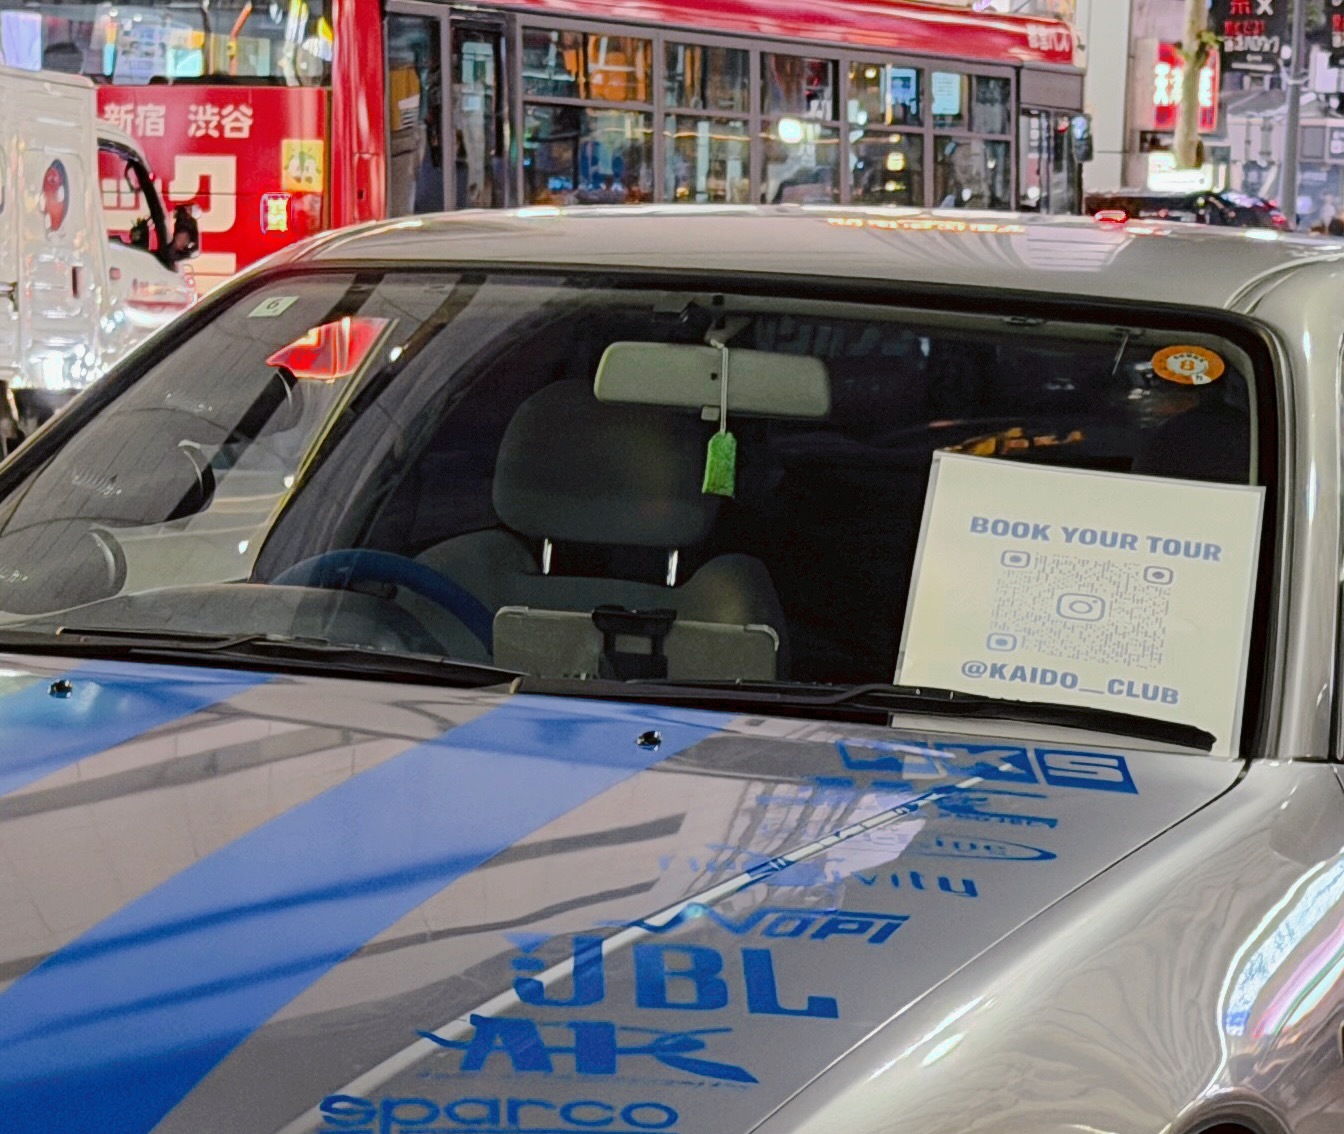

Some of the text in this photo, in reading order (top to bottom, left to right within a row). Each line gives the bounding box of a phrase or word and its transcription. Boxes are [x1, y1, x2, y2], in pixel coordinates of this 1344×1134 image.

[103, 103, 253, 138] 新宿 渋谷
[969, 516, 1223, 562] BOOK YOUR TOUR
[512, 936, 839, 1019] JBL
